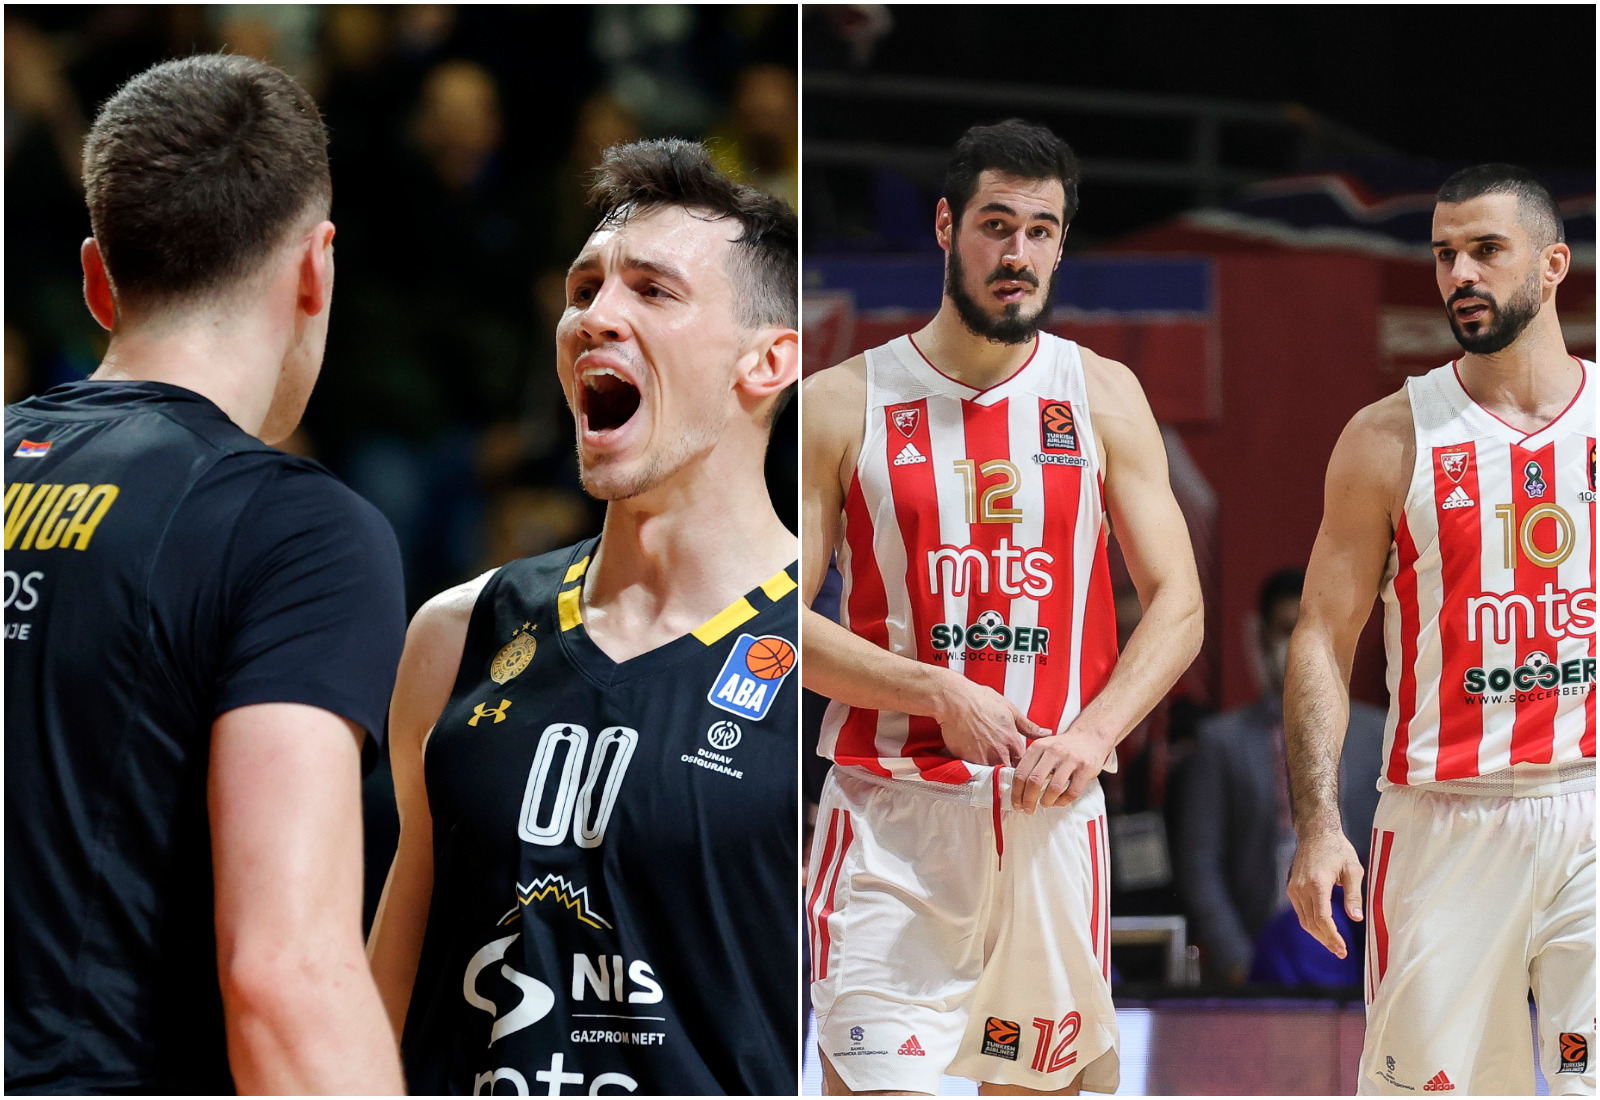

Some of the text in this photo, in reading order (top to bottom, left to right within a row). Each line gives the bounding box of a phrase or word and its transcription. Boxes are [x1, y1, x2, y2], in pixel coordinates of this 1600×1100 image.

[893, 455, 928, 466] adidas
[953, 459, 1023, 523] 12
[1442, 499, 1475, 510] adidas
[1495, 502, 1576, 569] 10
[927, 538, 1055, 598] mts
[1467, 583, 1596, 642] mts
[1464, 658, 1596, 693] SOCCER
[717, 673, 768, 712] ABA
[680, 754, 744, 779] OSIGURANJE
[697, 748, 733, 764] DUNAV
[518, 723, 639, 849] 00
[572, 953, 664, 1004] NIS
[570, 1030, 666, 1045] GAZPROM NEFT
[897, 1047, 926, 1056] adidas
[985, 1046, 1015, 1056] AIRLINES
[986, 1041, 1016, 1052] TURKISH
[1031, 1011, 1081, 1073] 12
[1423, 1083, 1456, 1091] adidas
